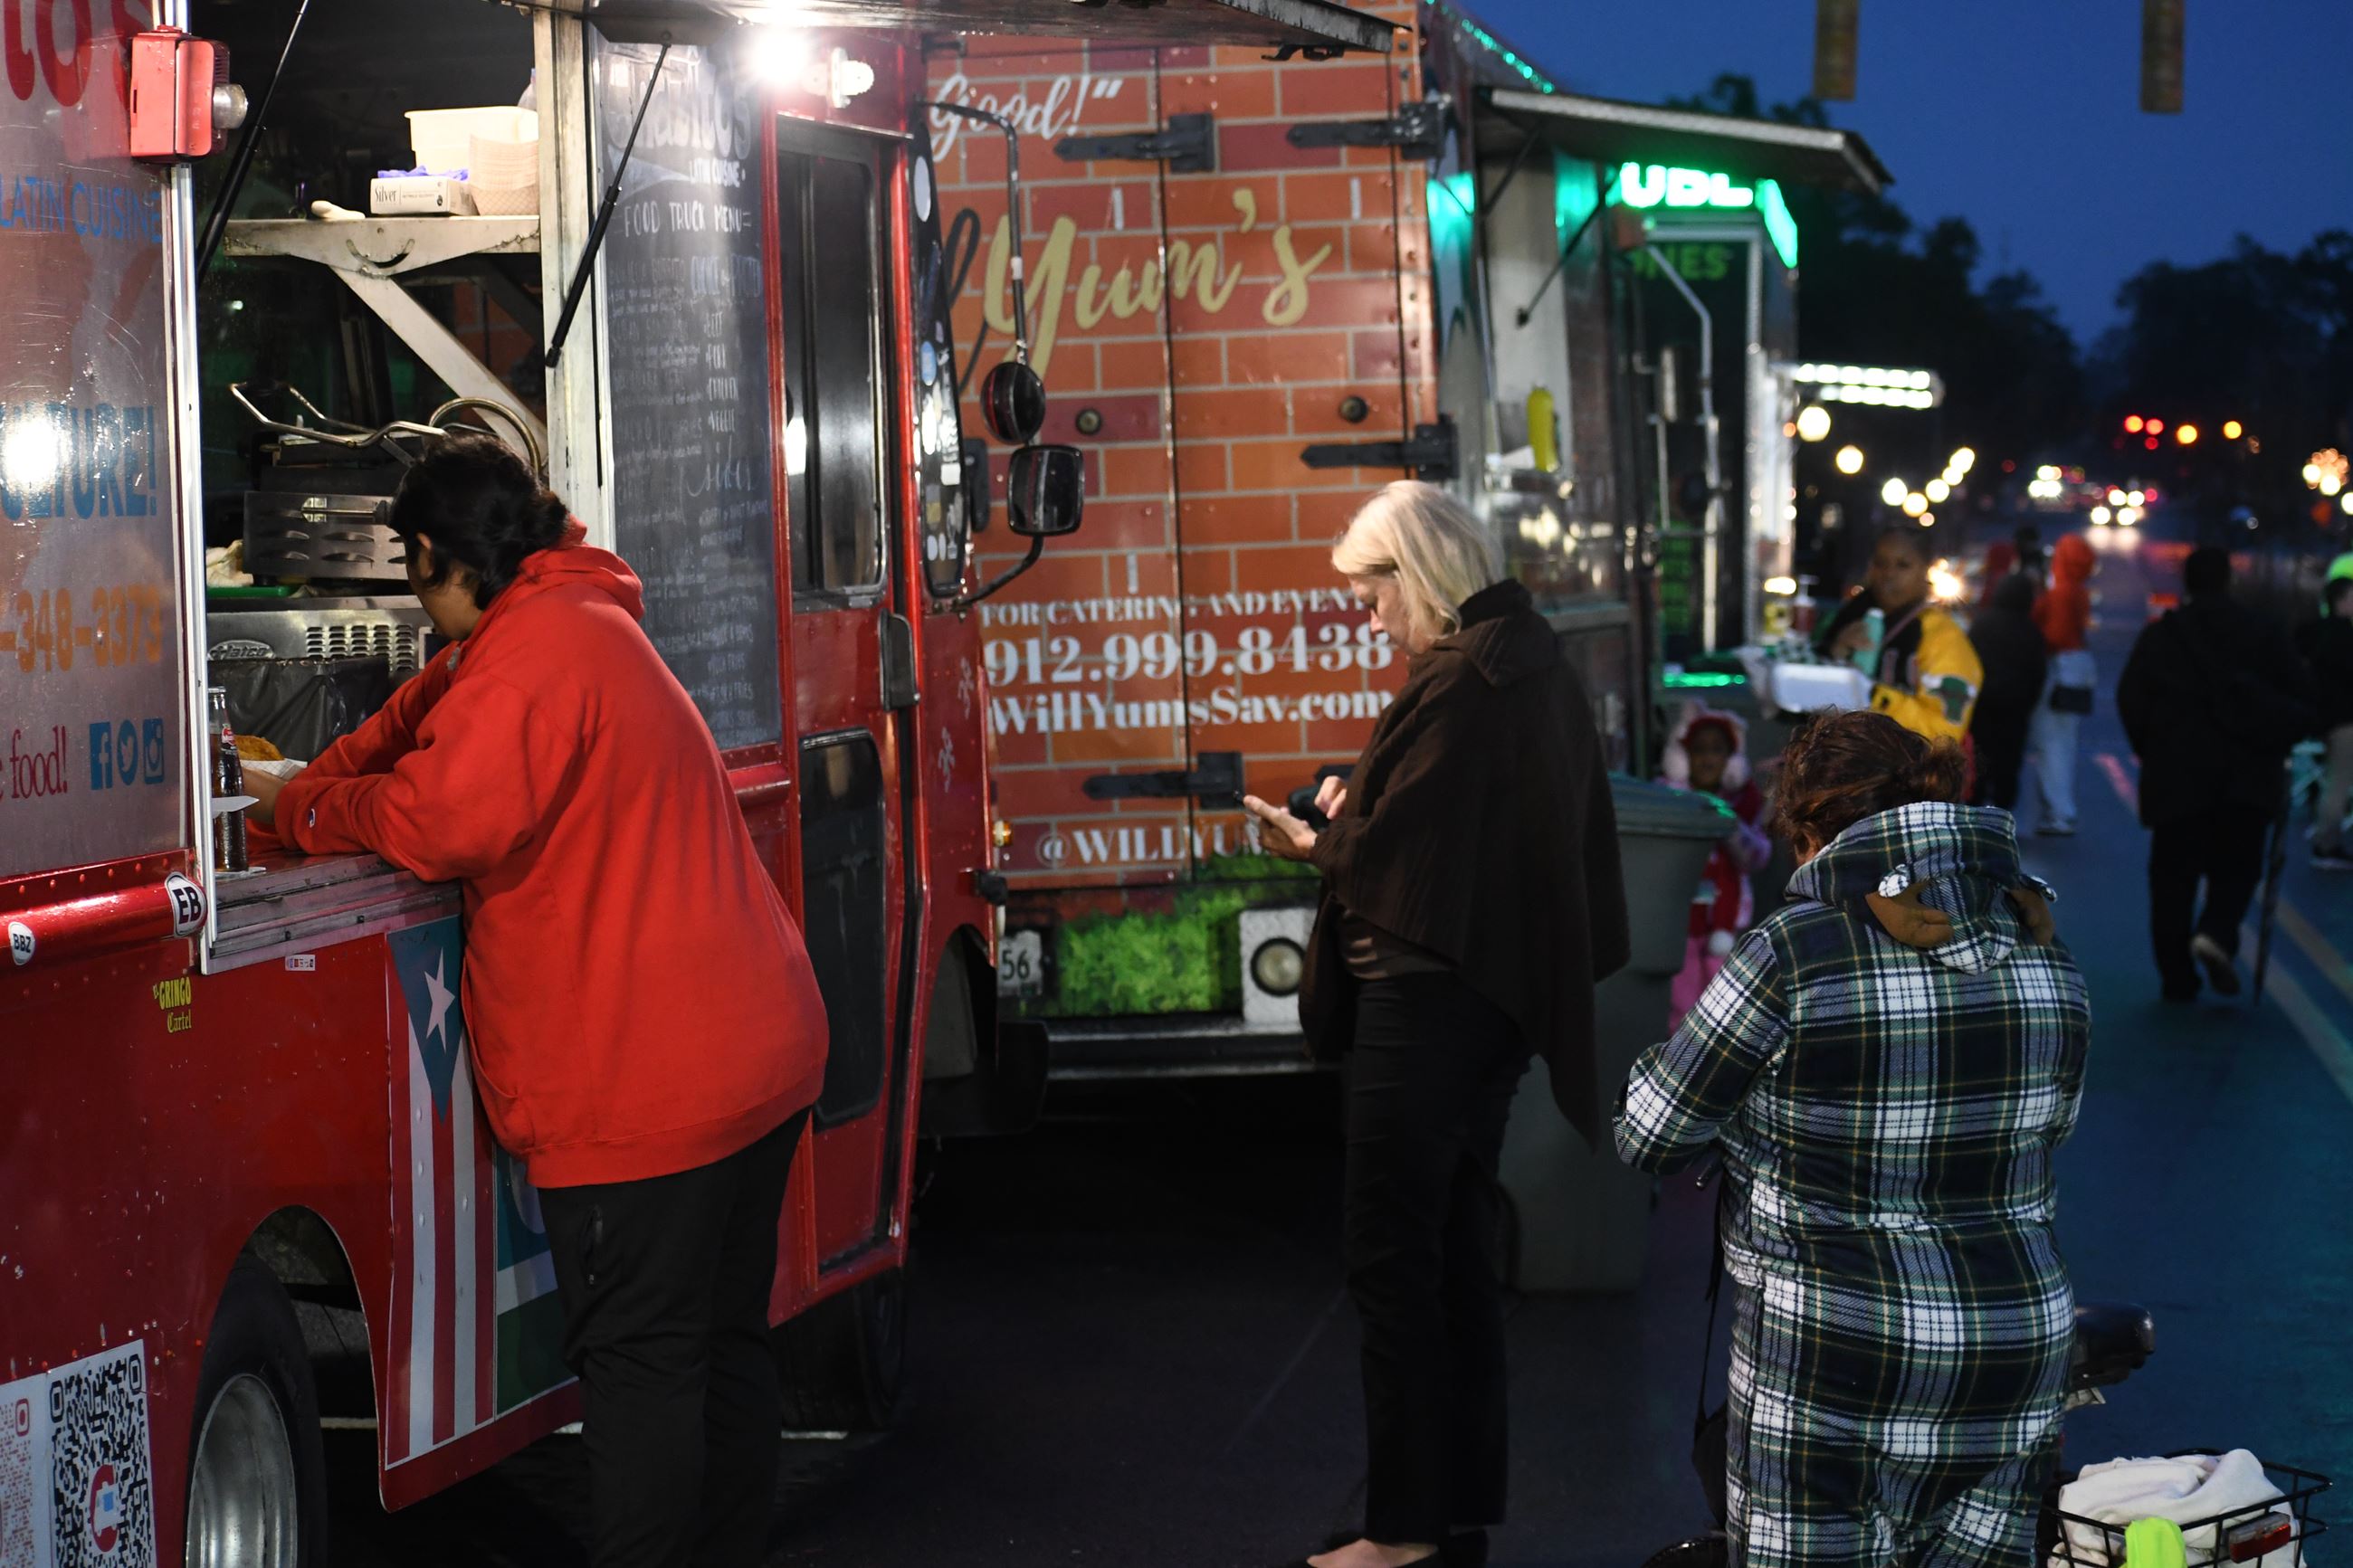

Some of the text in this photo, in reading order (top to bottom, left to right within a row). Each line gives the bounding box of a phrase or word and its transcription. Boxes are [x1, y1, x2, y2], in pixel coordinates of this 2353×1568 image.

[0, 173, 163, 245] LATIN CUISINE
[375, 185, 396, 202] Silver
[624, 200, 743, 237] FOOD TRUCK MENU
[983, 603, 1040, 627] FOR
[1210, 592, 1267, 616] AND
[984, 622, 1394, 687] 912.999.8438
[9, 725, 68, 799] food!
[172, 886, 202, 924] EB
[1002, 947, 1030, 981] 56
[159, 976, 192, 1010] GRINGO
[167, 1009, 192, 1033] Cartel
